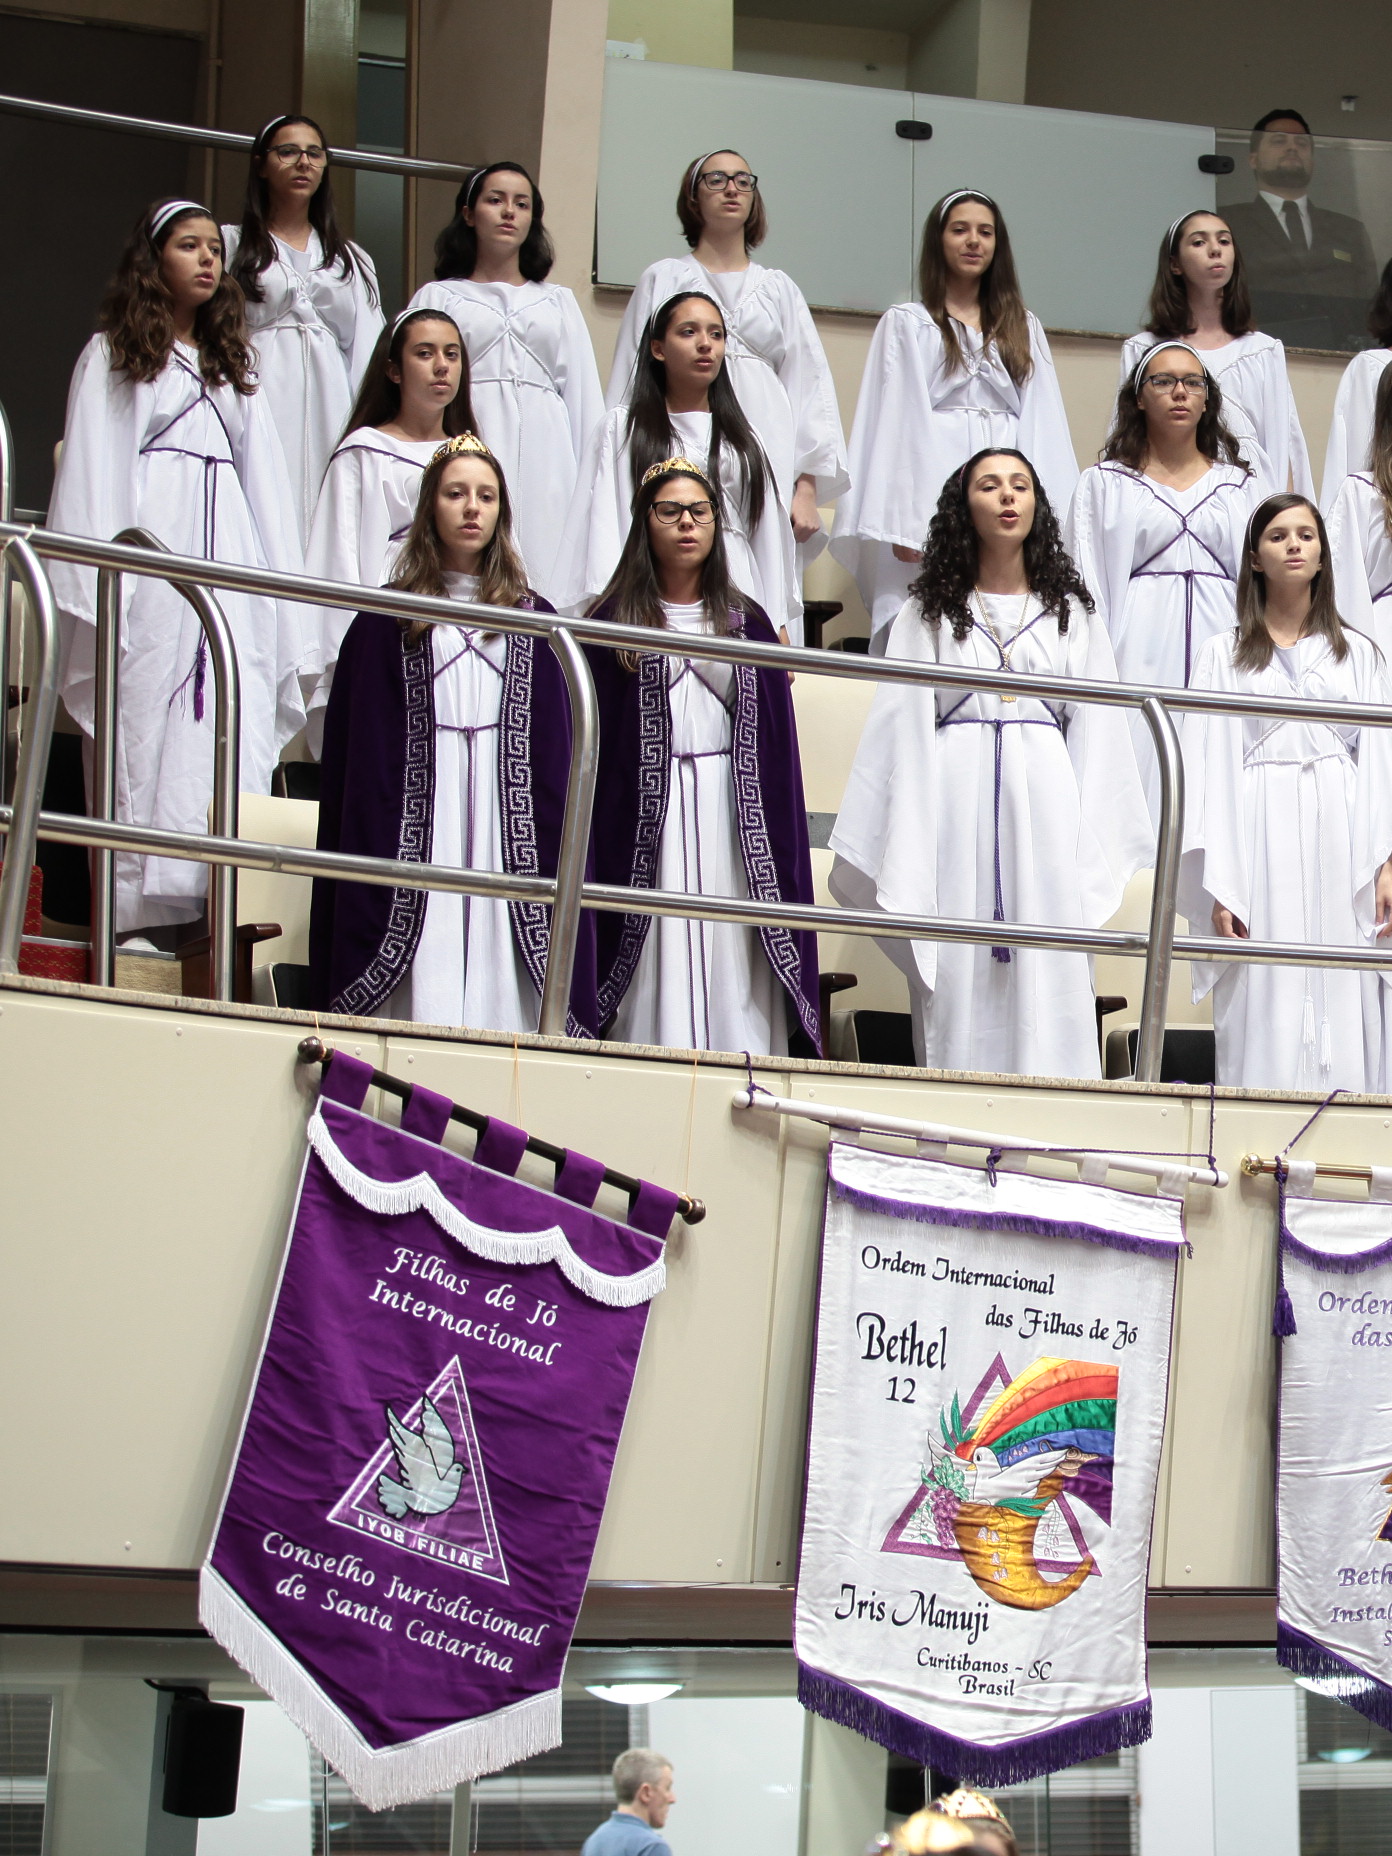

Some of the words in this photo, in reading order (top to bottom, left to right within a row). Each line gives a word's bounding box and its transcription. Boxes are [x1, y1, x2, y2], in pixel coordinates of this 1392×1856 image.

[385, 1247, 470, 1296] Filhas
[485, 1283, 516, 1311] de
[526, 1299, 558, 1327] Jó
[861, 1245, 926, 1277] Ordem
[932, 1257, 1055, 1295] Internacional
[368, 1280, 562, 1366] Internacional
[856, 1312, 947, 1371] Bethel
[985, 1304, 1013, 1328] das
[1018, 1307, 1083, 1339] Filhas
[1089, 1319, 1109, 1340] de
[1112, 1320, 1138, 1350] Jó
[885, 1376, 916, 1404] 12
[357, 1515, 405, 1544] IYOB
[417, 1536, 484, 1570] FILIAE
[262, 1531, 376, 1587] Conselho
[384, 1575, 550, 1647] Jurisdicional
[834, 1583, 886, 1622] Iris
[891, 1589, 990, 1645] Manuji
[276, 1574, 307, 1601] de
[321, 1588, 393, 1631] Santa
[406, 1619, 514, 1674] Catarina
[917, 1647, 1009, 1674] Curitibanos
[1027, 1660, 1053, 1681] SC
[958, 1674, 1016, 1697] Brasil
